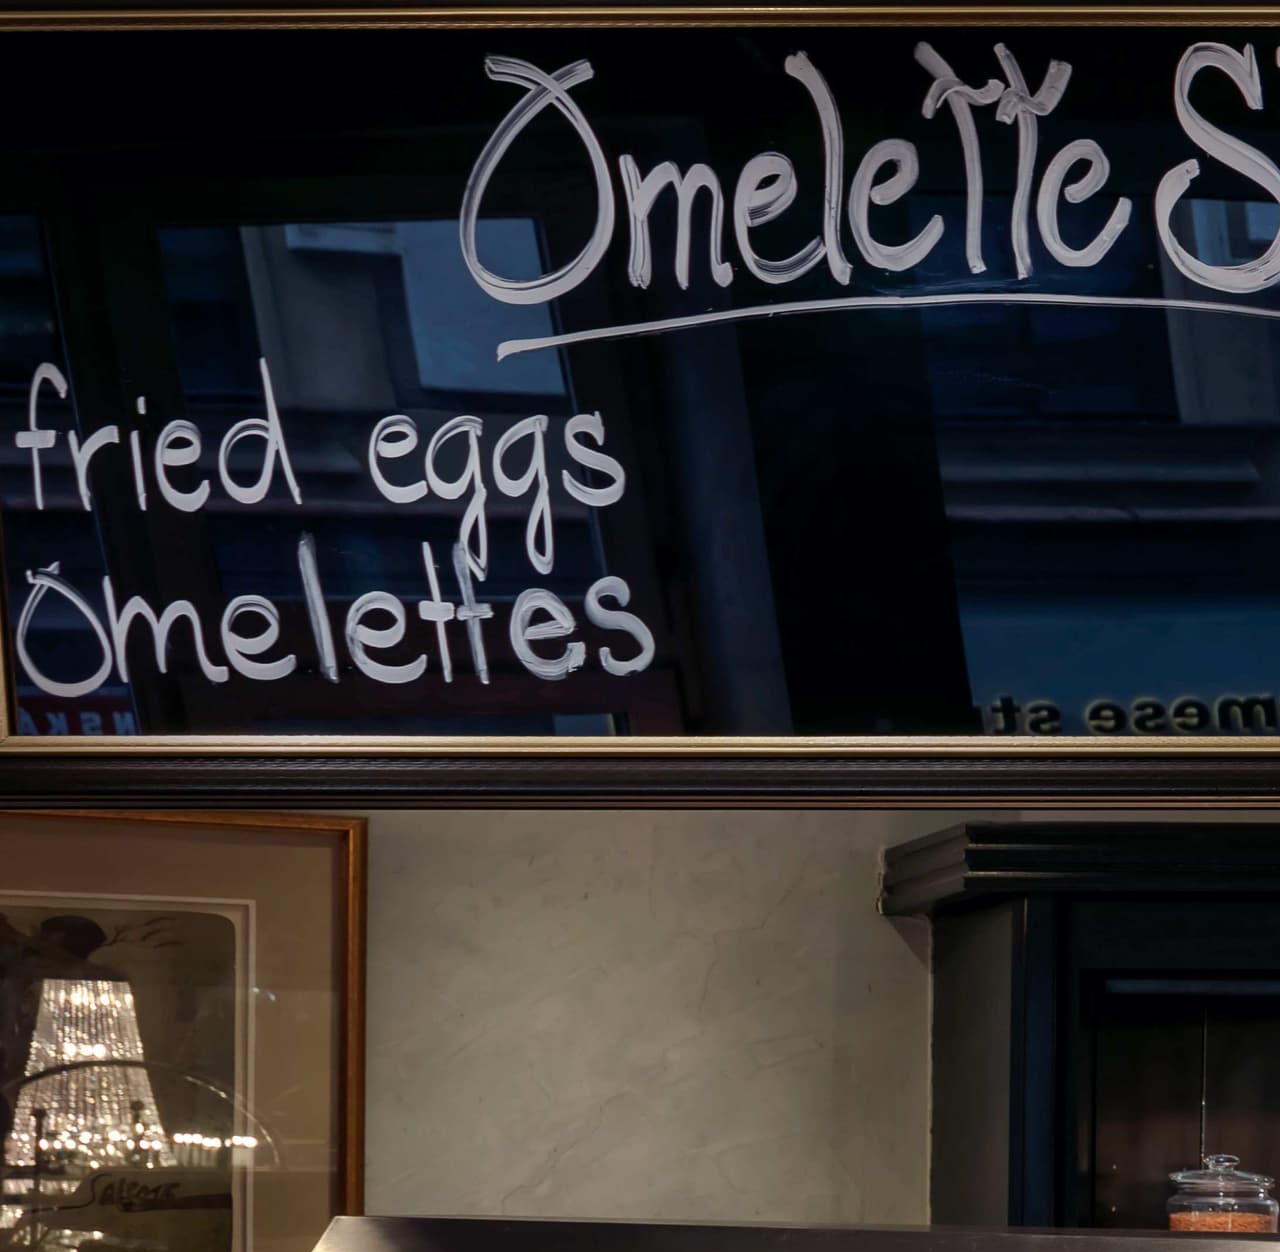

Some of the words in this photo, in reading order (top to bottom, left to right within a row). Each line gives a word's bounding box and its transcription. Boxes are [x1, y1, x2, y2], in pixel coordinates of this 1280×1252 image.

[460, 44, 1132, 304] Omelette
[15, 358, 303, 512] fried
[369, 411, 625, 581] eggs
